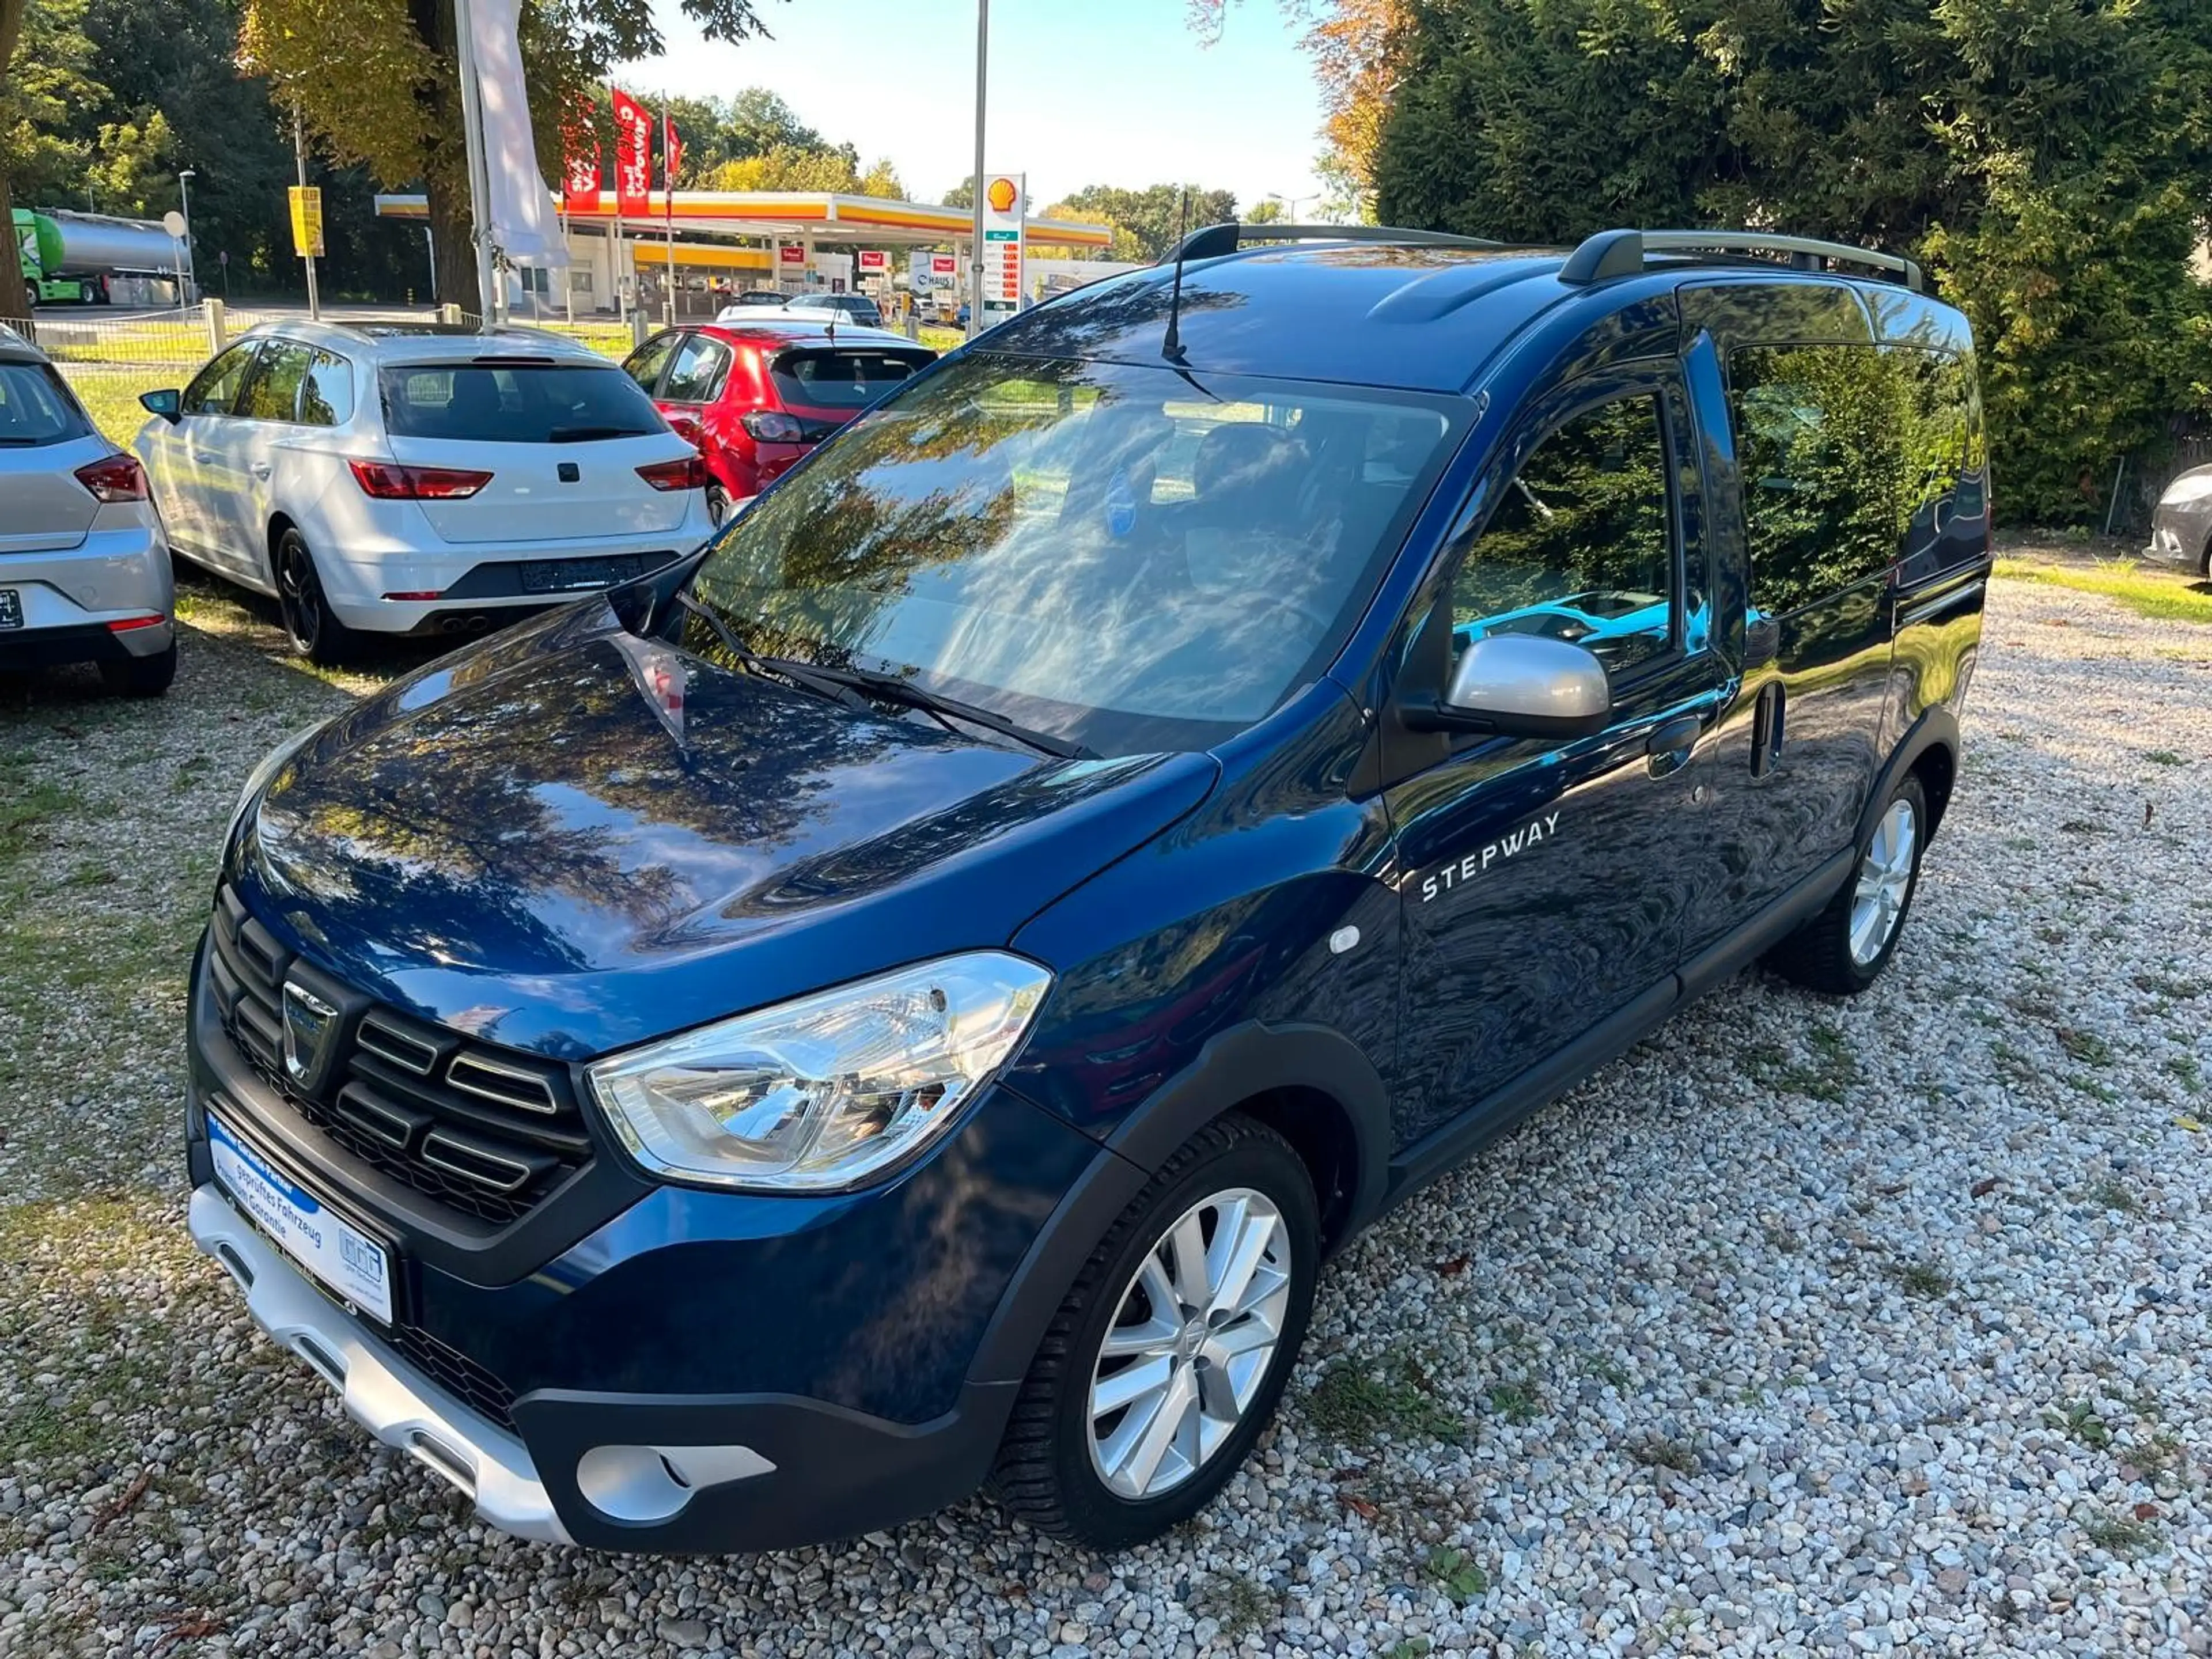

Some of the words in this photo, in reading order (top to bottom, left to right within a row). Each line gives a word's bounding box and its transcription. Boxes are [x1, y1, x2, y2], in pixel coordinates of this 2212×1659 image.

[1422, 810, 1560, 903] STEPWAY
[236, 1164, 276, 1212] geprüftes
[276, 1198, 322, 1249] Fahrzeug
[248, 1194, 287, 1239] Garantie
